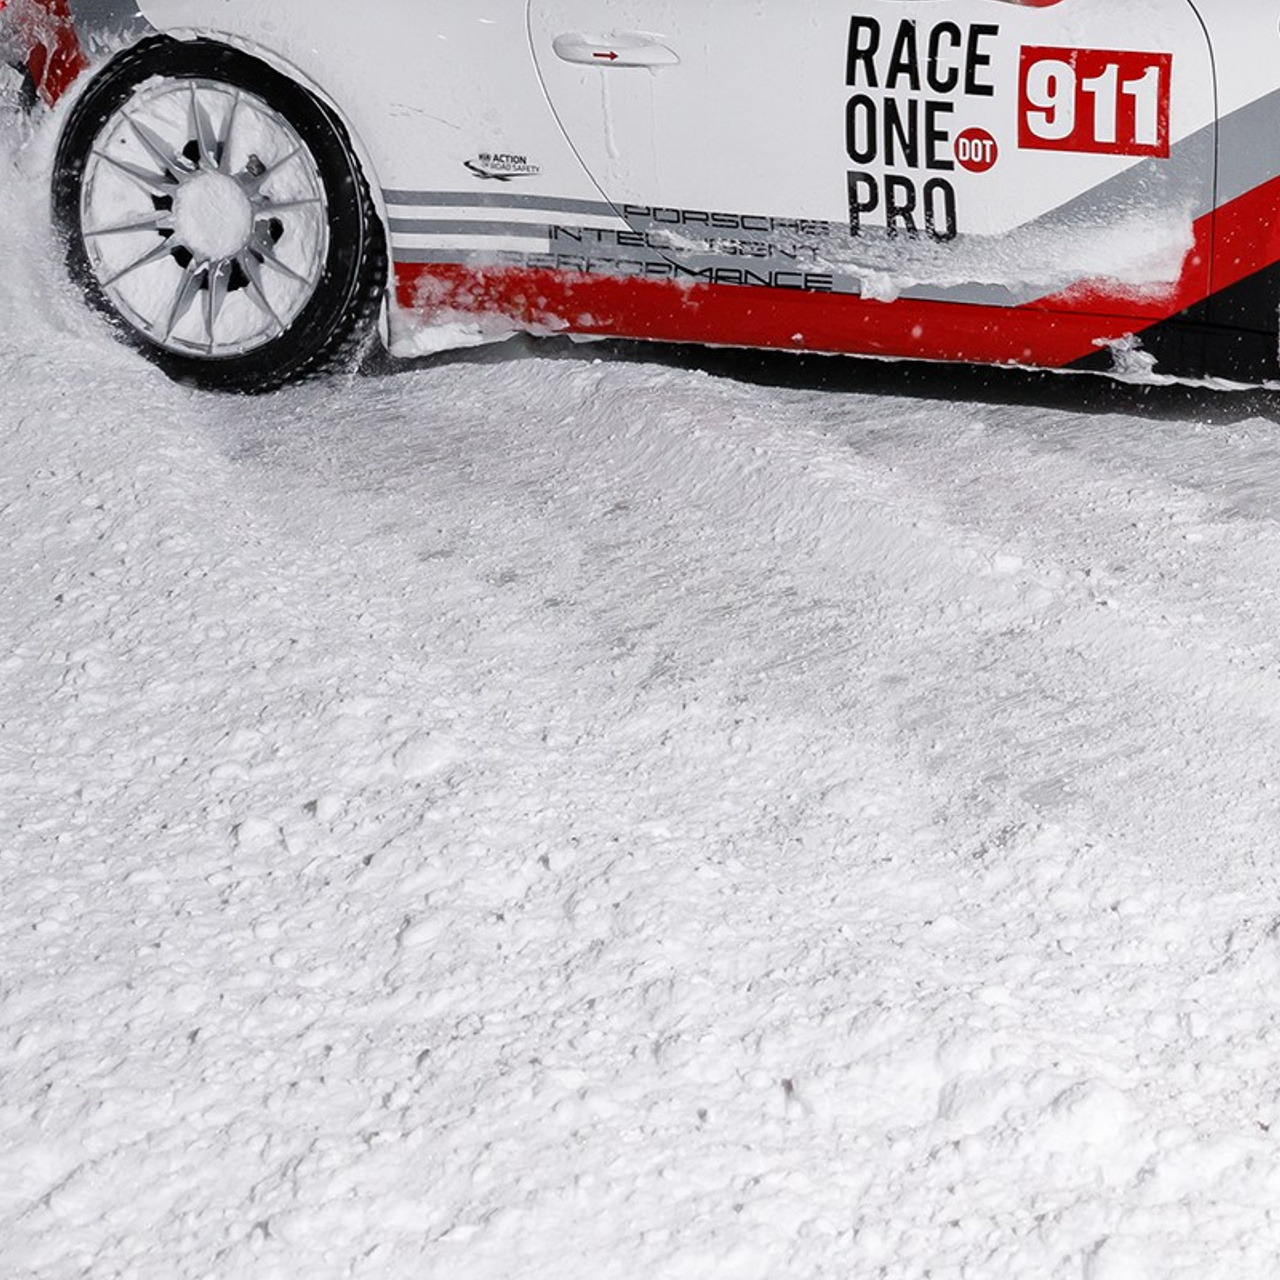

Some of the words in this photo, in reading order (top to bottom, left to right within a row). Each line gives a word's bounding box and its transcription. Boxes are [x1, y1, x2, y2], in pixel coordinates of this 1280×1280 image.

[845, 15, 999, 97] RACE
[1026, 58, 1160, 146] 911
[493, 154, 527, 164] ACTION
[845, 93, 956, 170] ONE
[958, 138, 993, 163] DOT
[624, 204, 829, 235] PORSCHE
[846, 170, 958, 243] PRO
[548, 224, 820, 262] INTELIGENT
